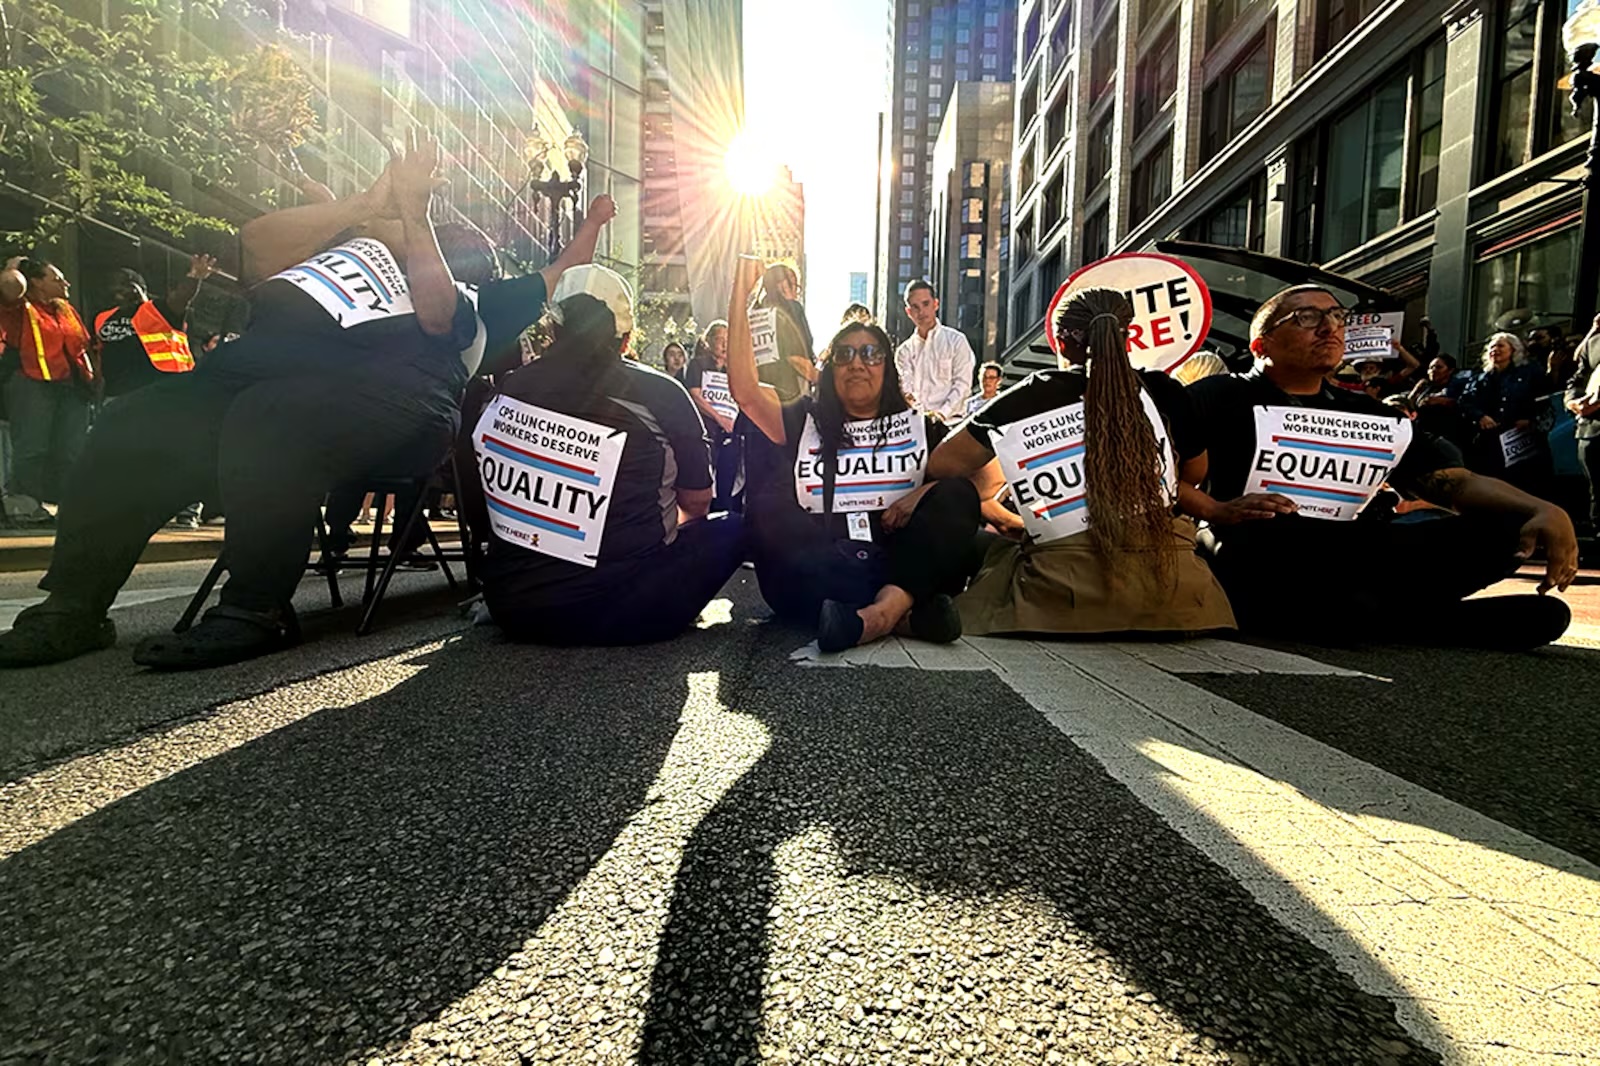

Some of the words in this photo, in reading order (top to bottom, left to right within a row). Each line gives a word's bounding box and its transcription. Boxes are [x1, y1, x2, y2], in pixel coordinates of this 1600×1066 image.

[309, 254, 391, 314] ALITY
[363, 250, 402, 297] DESERVE
[1124, 276, 1191, 317] ITE
[752, 331, 775, 347] LITY
[1126, 310, 1192, 352] RE!
[1345, 340, 1389, 352] QUALITY
[499, 405, 515, 421] CPS
[515, 413, 600, 447] LUNCHROOM
[1022, 422, 1048, 437] CPS
[1023, 424, 1084, 450] WORKERS
[1283, 423, 1339, 438] WORKERS
[1341, 430, 1395, 443] DESERVE
[1285, 413, 1309, 423] CPS
[1311, 415, 1390, 432] LUNCHROOM
[493, 419, 539, 444] WORKERS
[540, 439, 600, 462] DESERVE
